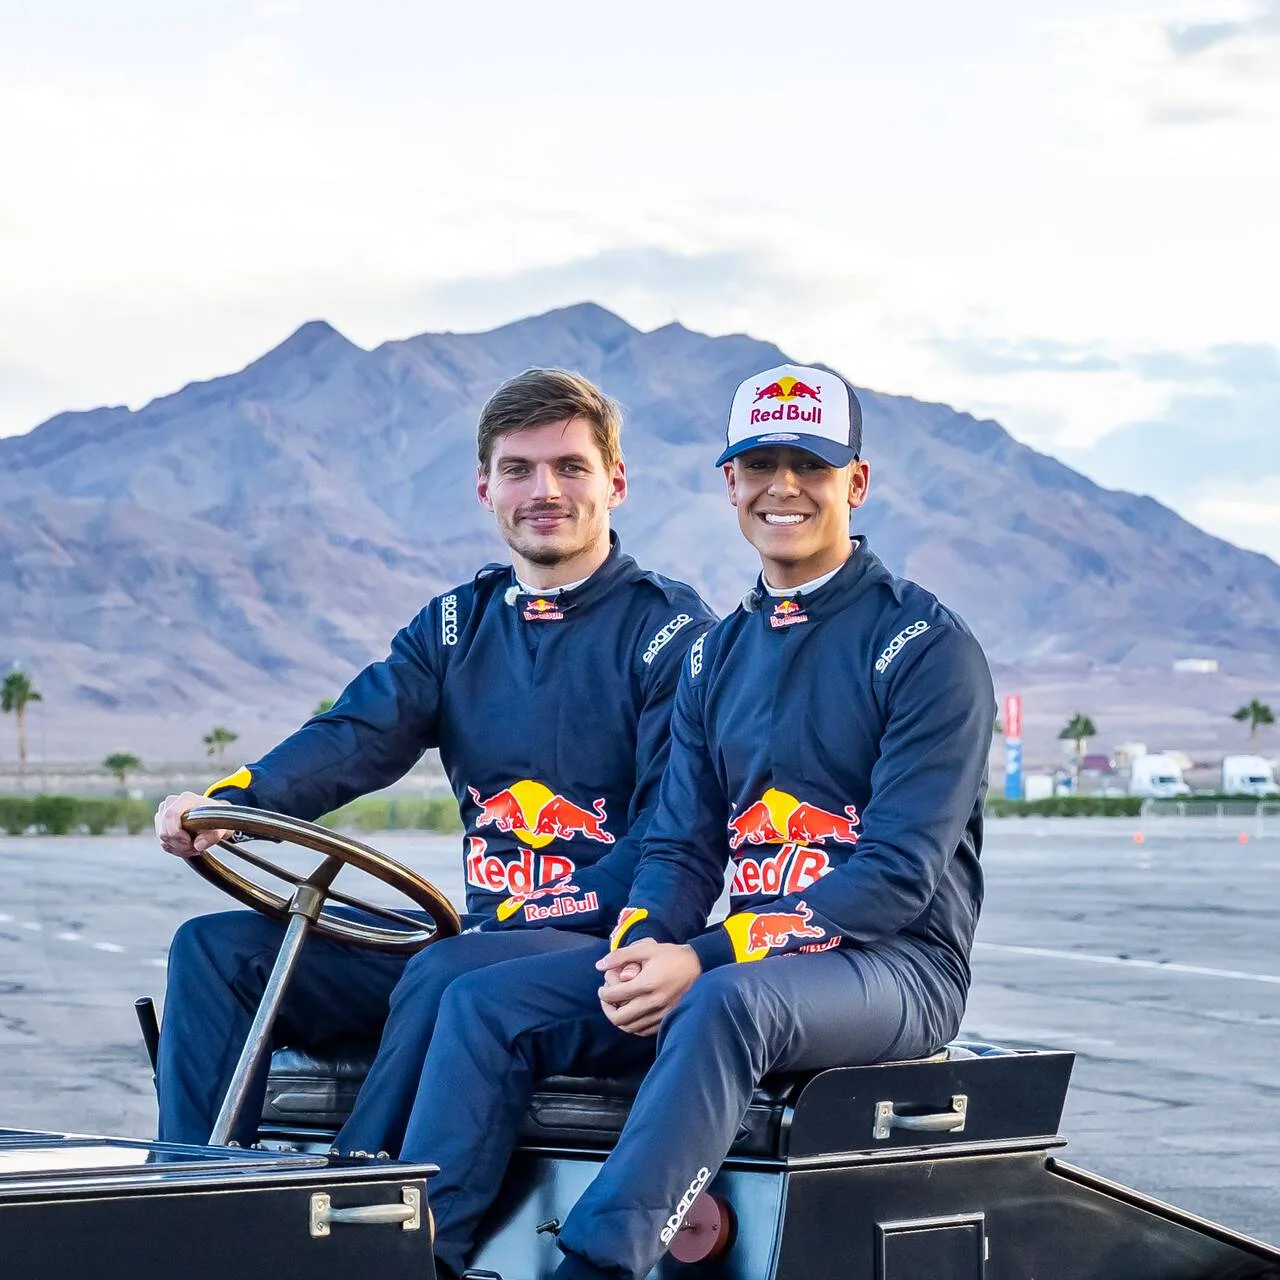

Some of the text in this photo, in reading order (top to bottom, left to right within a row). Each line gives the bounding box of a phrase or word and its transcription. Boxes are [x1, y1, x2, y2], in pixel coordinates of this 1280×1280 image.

[750, 403, 822, 425] Red Bull
[466, 837, 534, 895] Red
[524, 892, 599, 921] Red Bull
[660, 1167, 710, 1245] sparco
